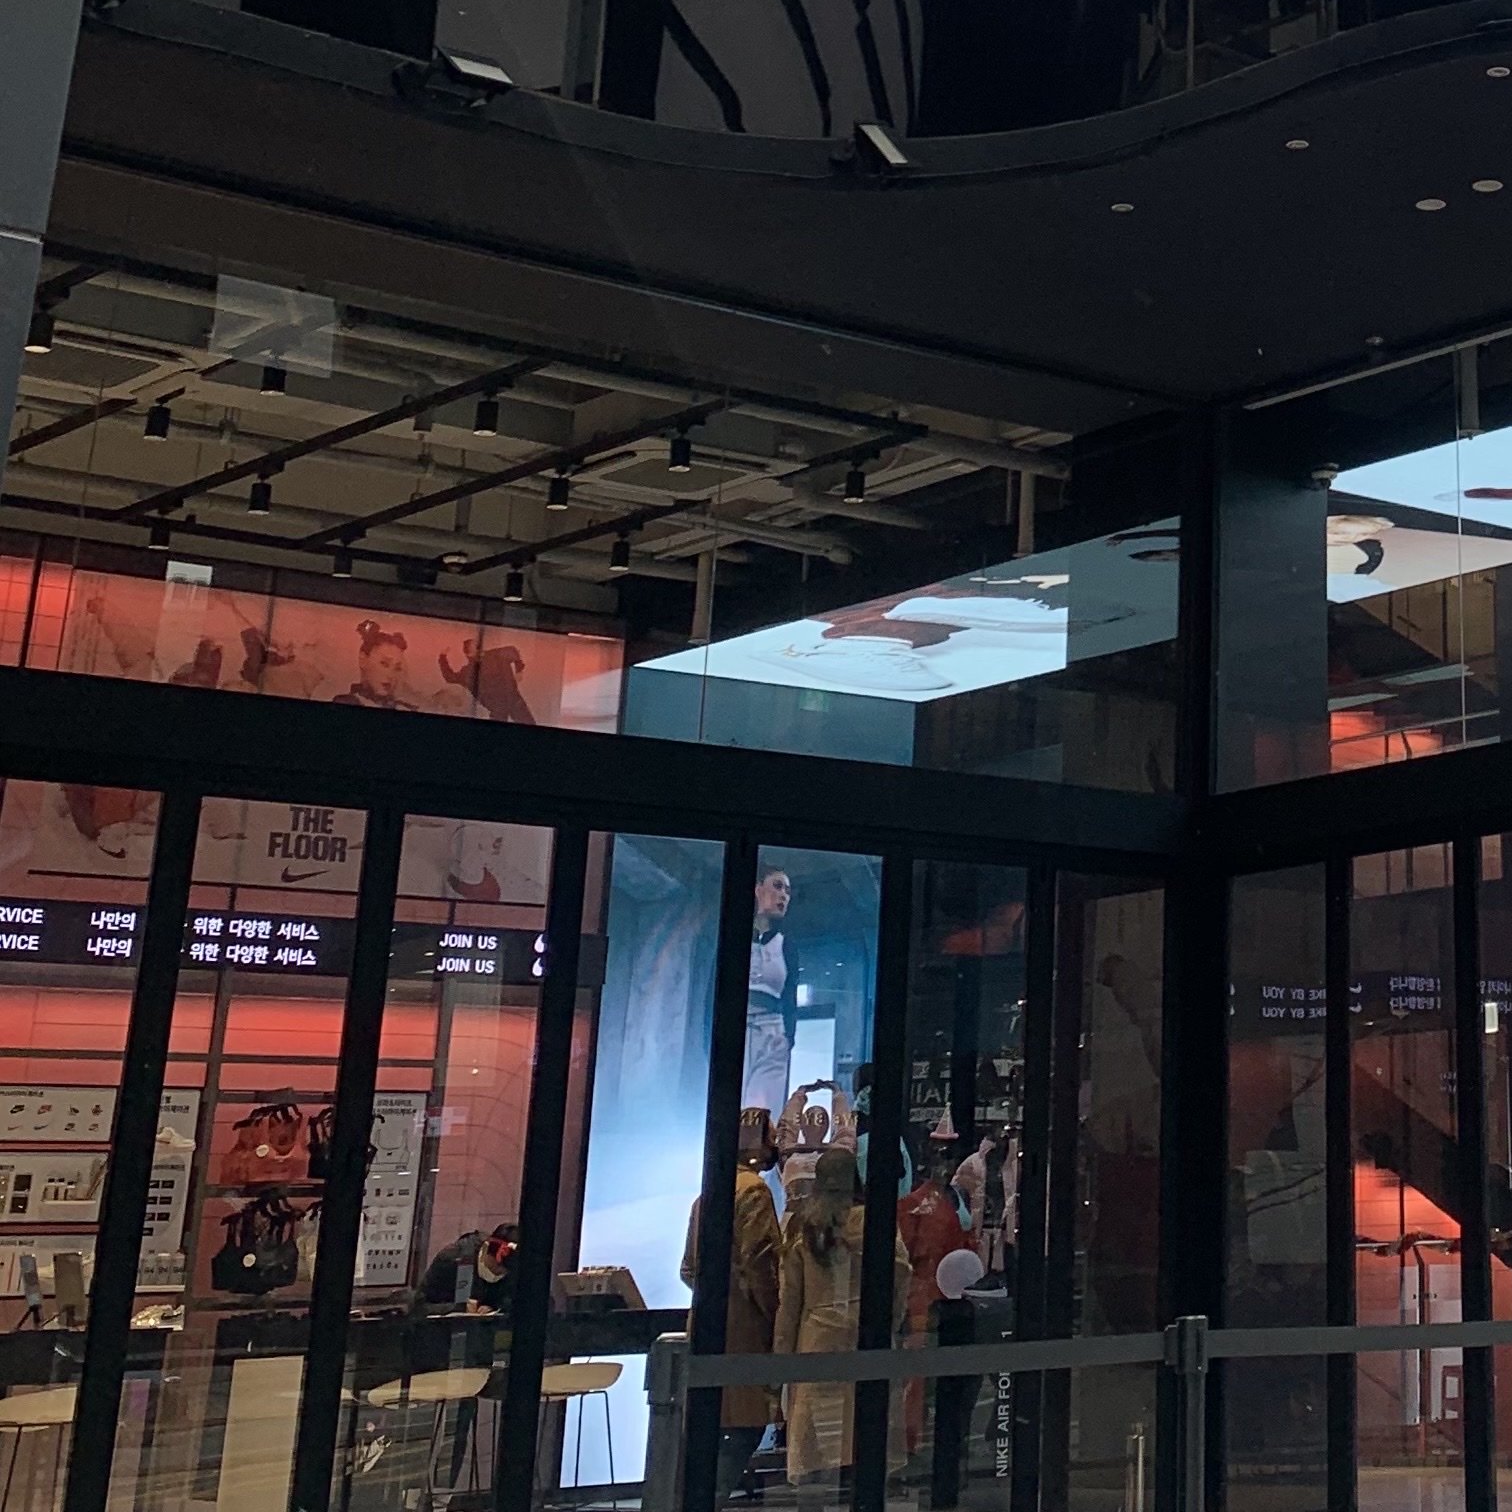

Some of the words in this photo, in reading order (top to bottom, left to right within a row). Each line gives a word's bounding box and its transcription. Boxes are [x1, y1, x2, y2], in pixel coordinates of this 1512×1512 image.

[290, 807, 335, 834] THE
[268, 832, 348, 862] FLOOR
[90, 911, 136, 931] 나만의
[193, 917, 224, 936] 위한
[229, 919, 272, 939] 다양한
[277, 922, 320, 941] 서비스
[0, 934, 39, 950] VICE
[86, 938, 132, 957] 나만의
[439, 933, 473, 948] JOIN
[477, 936, 498, 950] US
[189, 943, 220, 962] 위한
[225, 944, 269, 964] 다양한
[273, 948, 317, 966] 서비스
[437, 957, 471, 972] JOIN
[475, 960, 496, 974] US
[998, 1405, 1009, 1432] AIR
[996, 1437, 1008, 1477] NIKE
